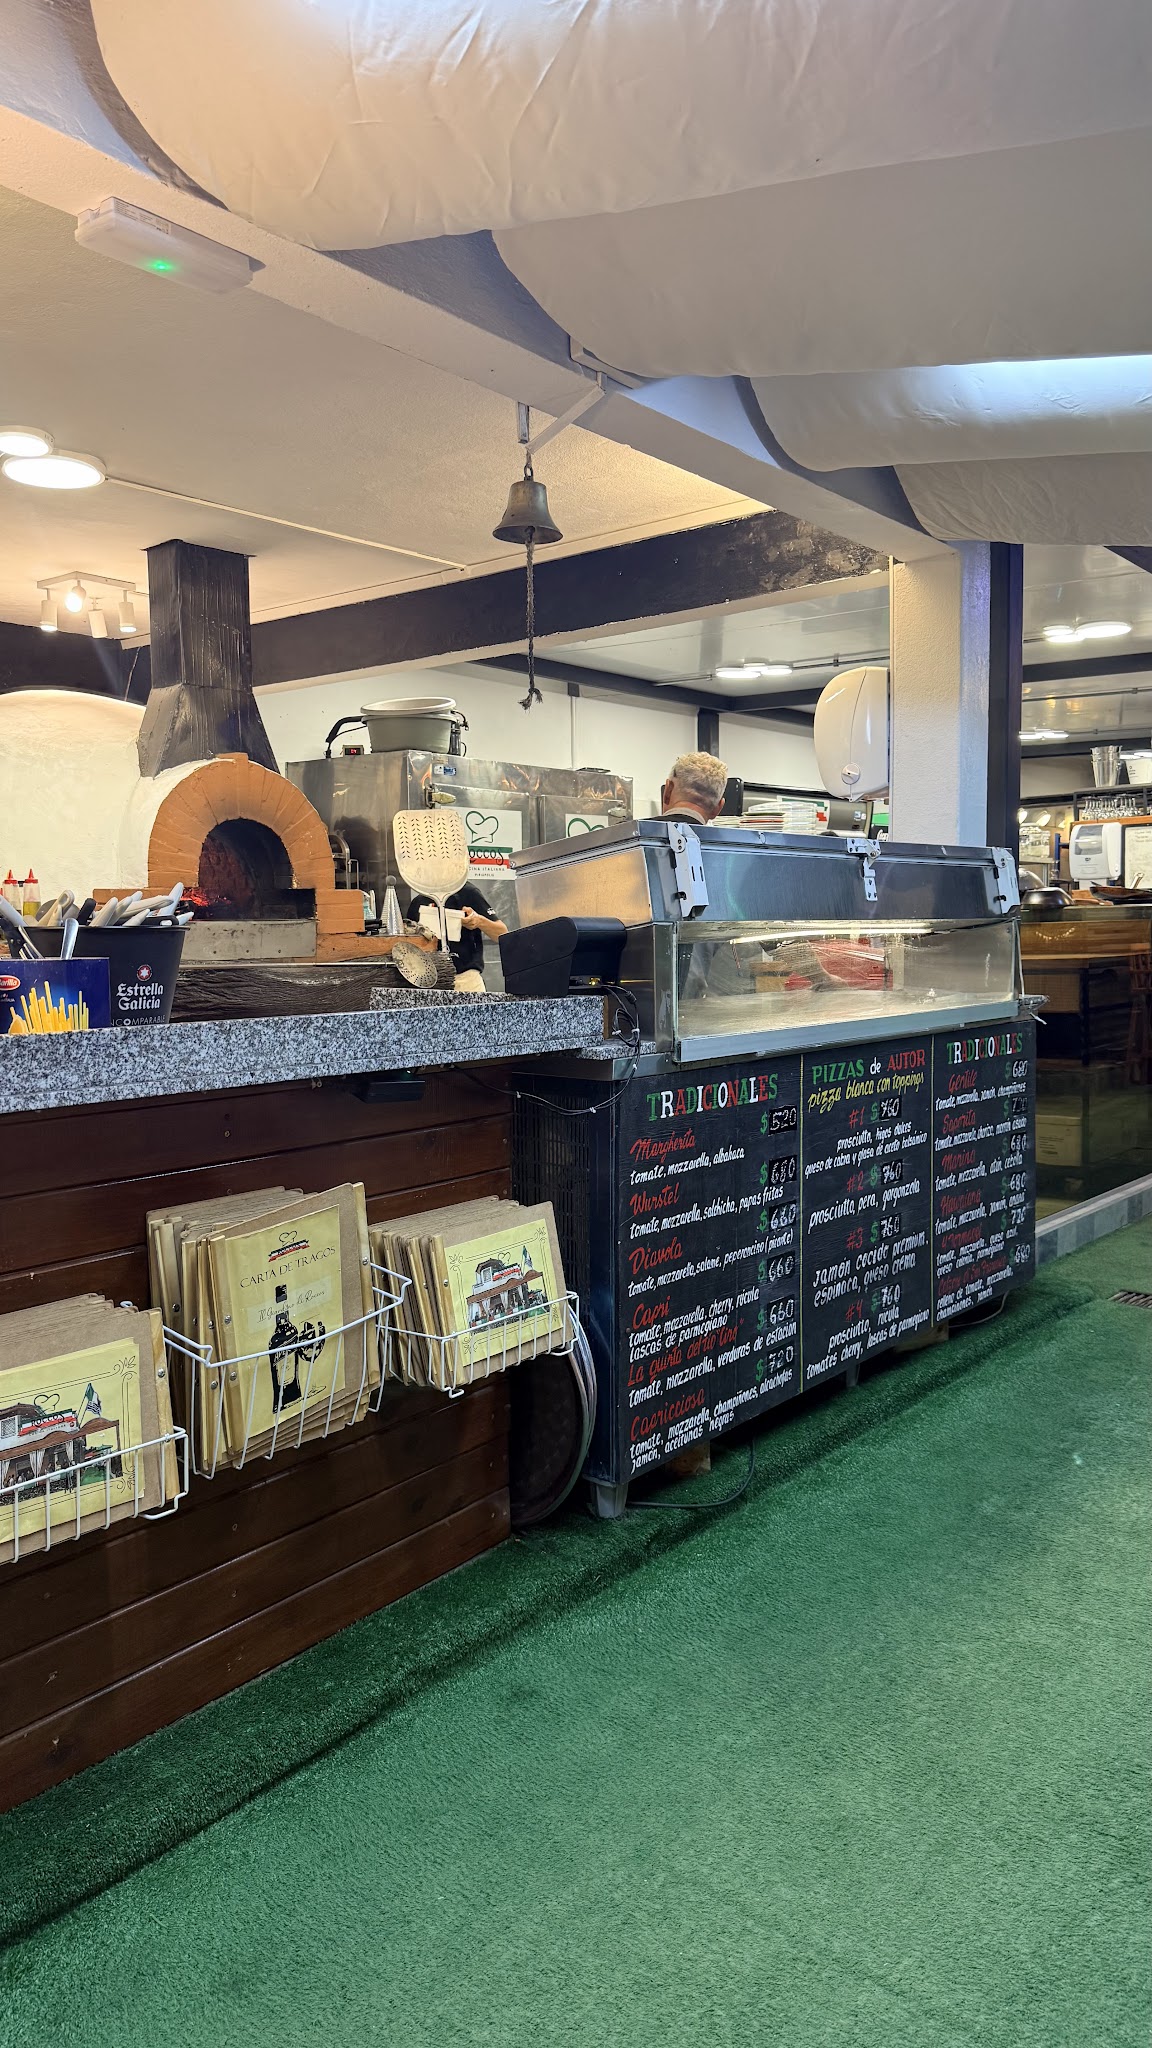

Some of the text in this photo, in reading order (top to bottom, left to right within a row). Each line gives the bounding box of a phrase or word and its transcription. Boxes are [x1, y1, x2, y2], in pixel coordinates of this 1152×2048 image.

[0, 978, 18, 986] arilla
[116, 982, 164, 997] Estrella
[110, 1015, 166, 1027] NCOMPARABLE
[118, 996, 160, 1011] Galicia
[812, 1049, 926, 1085] PIZZAS de AUTOR
[946, 1032, 1023, 1065] TRADICIONALES
[647, 1073, 778, 1121] TRADICIONALES
[807, 1070, 924, 1114] pizza blanca con toppings
[629, 1128, 695, 1163] Margherita
[804, 1160, 824, 1180] queso
[825, 1156, 833, 1169] de
[834, 1152, 851, 1168] cabra
[852, 1152, 858, 1165] y
[876, 1143, 884, 1156] de
[630, 1145, 745, 1185] tomate, mozzarella, albahaca
[847, 1170, 864, 1193] #2
[629, 1182, 680, 1216] Wurstel
[630, 1185, 784, 1240] tomate, mozzarella, salchicha, papas fritas
[857, 1193, 879, 1215] pera,
[882, 1178, 920, 1211] gorgonzola
[629, 1236, 683, 1276] Diavola
[846, 1227, 863, 1251] #3
[856, 1243, 890, 1271] cocido
[240, 1269, 277, 1288] CARTA
[279, 1261, 294, 1275] DE
[295, 1245, 336, 1268] TRAGOS
[628, 1279, 658, 1298] tomate,
[657, 1261, 696, 1289] mozzarella,
[696, 1256, 722, 1274] salame,
[814, 1252, 916, 1308] espinaca, queso crema
[629, 1324, 663, 1348] tomate,
[663, 1305, 708, 1335] mozzarella,
[708, 1298, 734, 1318] cherry,
[632, 1295, 671, 1330] Capri
[845, 1299, 863, 1322] #4
[627, 1363, 644, 1387] La
[648, 1345, 683, 1383] quinta
[686, 1335, 702, 1360] del
[630, 1337, 662, 1364] lascas
[665, 1332, 677, 1349] de
[806, 1352, 838, 1380] tomates
[840, 1341, 863, 1361] cherry,
[866, 1328, 888, 1349] lascas
[889, 1324, 897, 1338] de
[628, 1379, 663, 1408] tomate,
[666, 1356, 715, 1391] mozzarella,
[717, 1342, 751, 1368] verduras
[753, 1335, 764, 1352] de
[630, 1432, 664, 1460] tomate,
[667, 1406, 712, 1440] mozzarella,
[664, 1427, 704, 1453] aceitunas
[709, 1411, 735, 1432] negras
